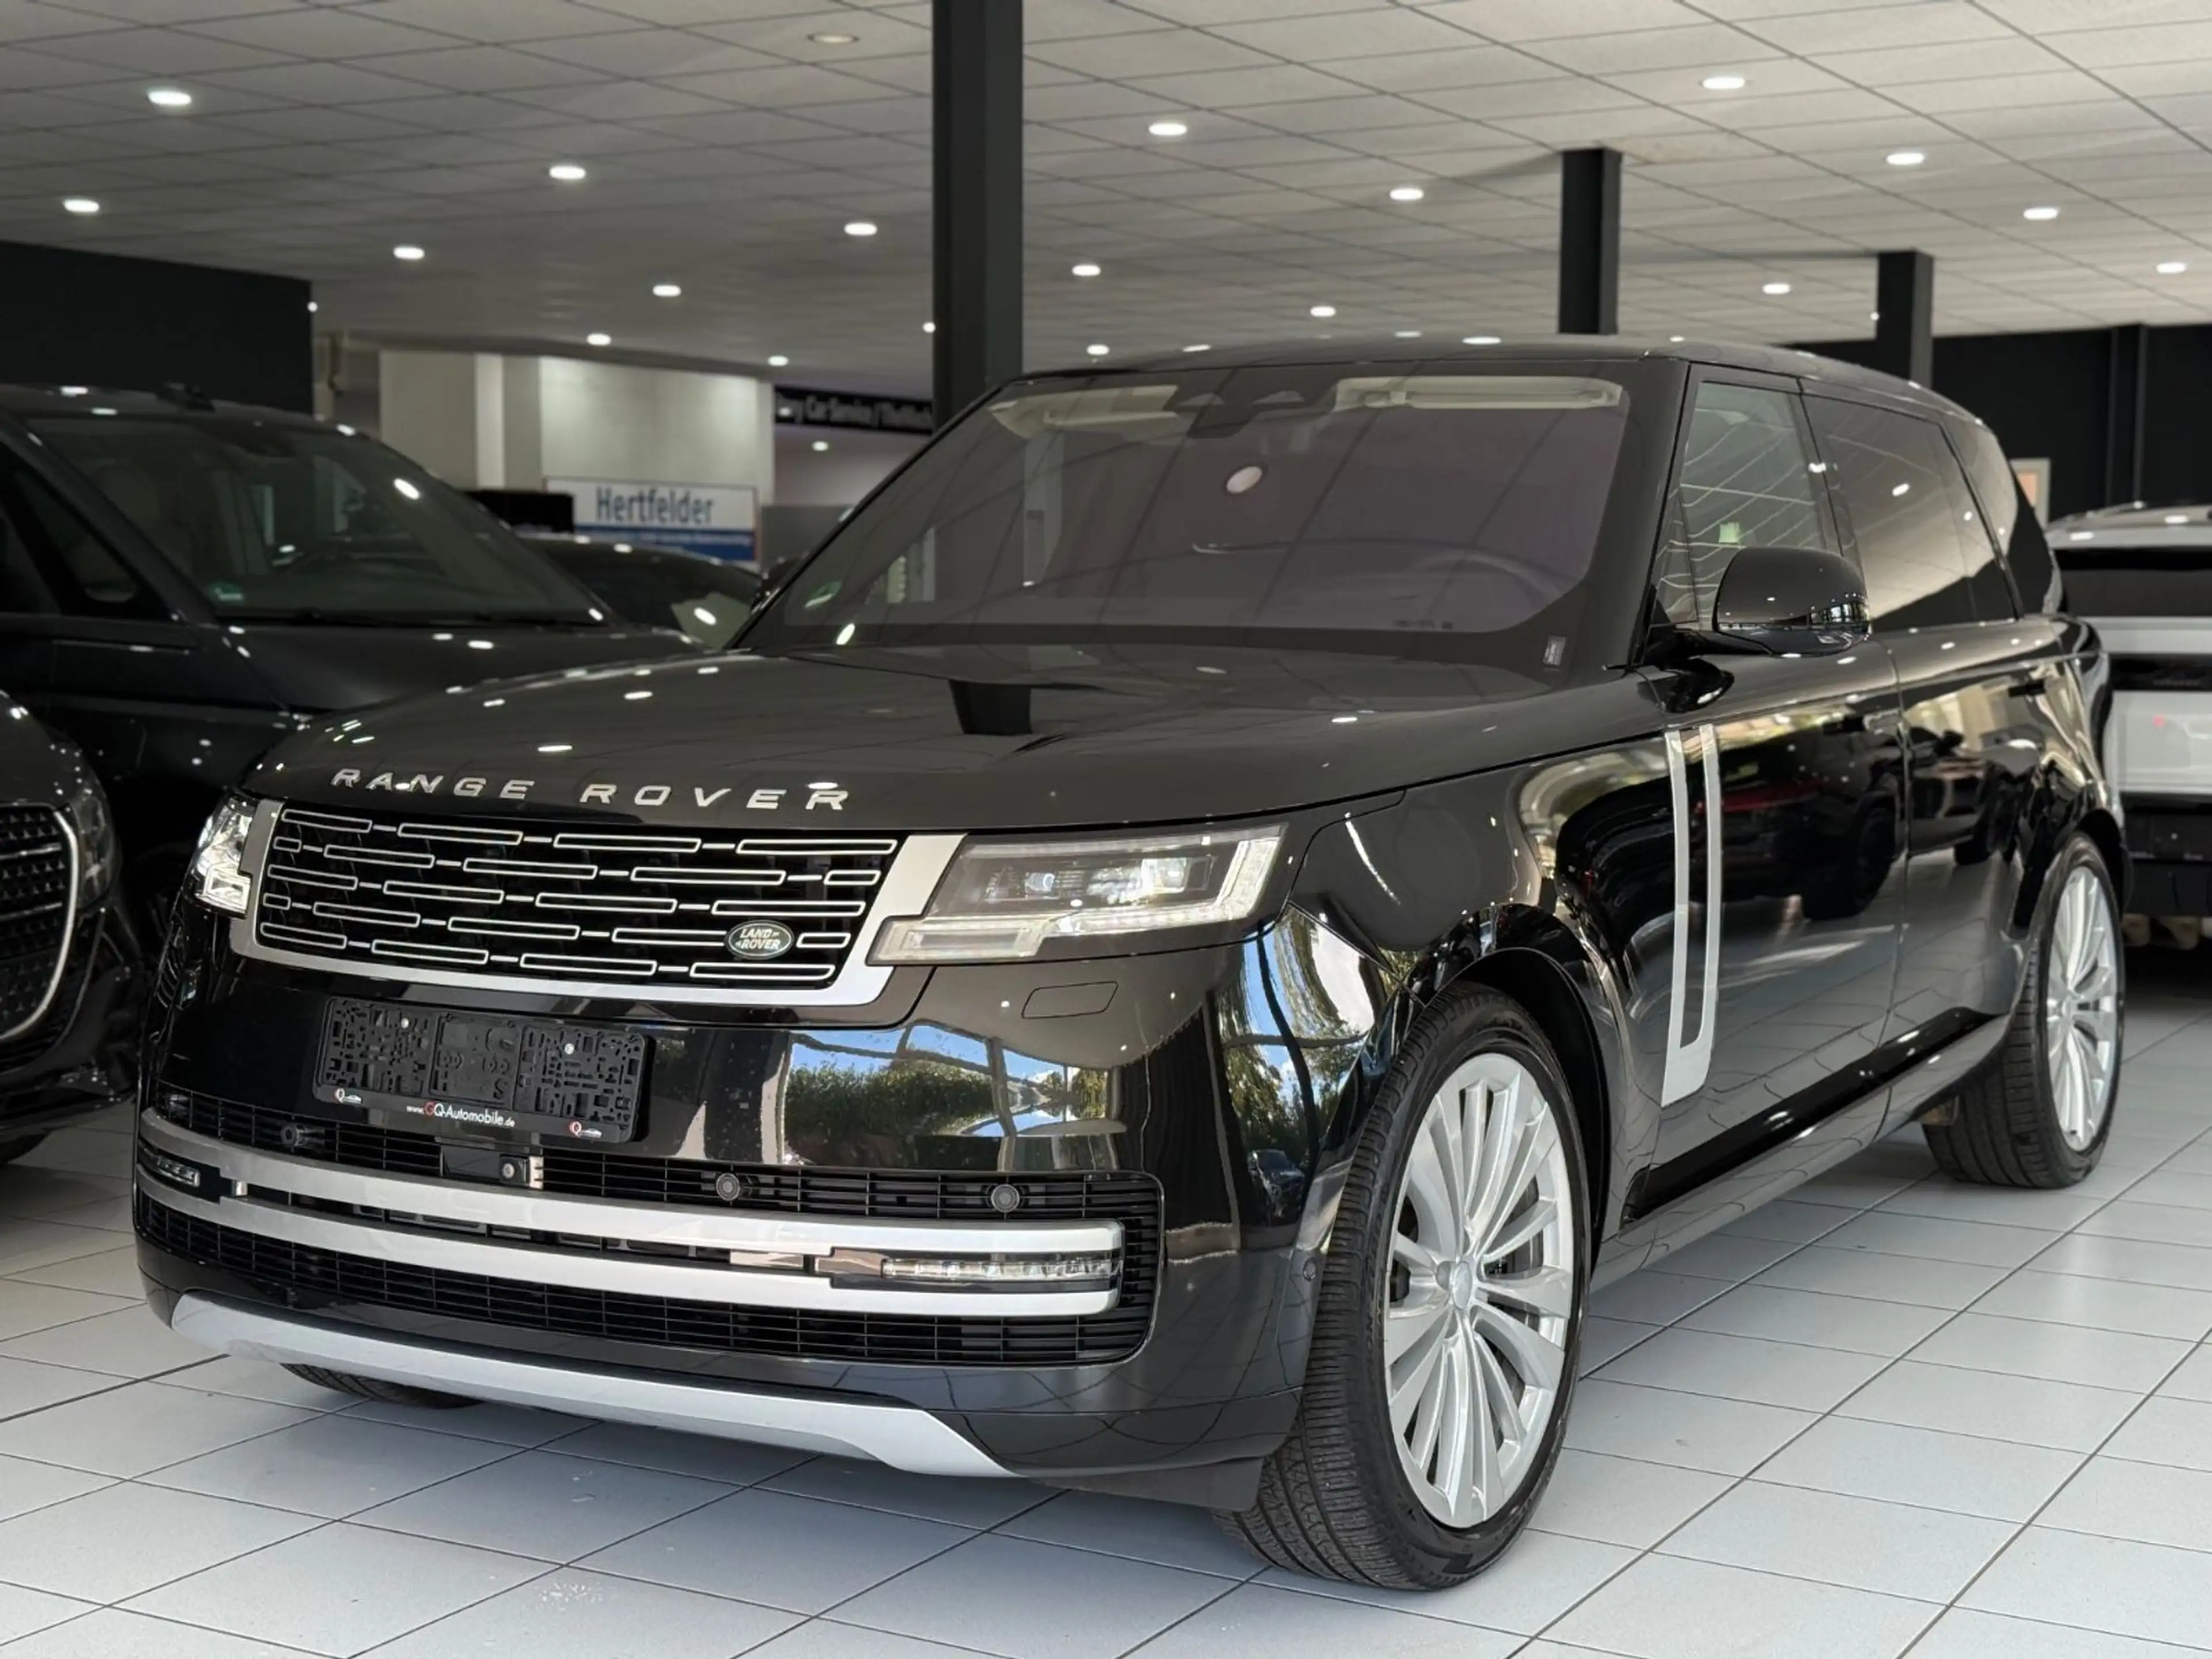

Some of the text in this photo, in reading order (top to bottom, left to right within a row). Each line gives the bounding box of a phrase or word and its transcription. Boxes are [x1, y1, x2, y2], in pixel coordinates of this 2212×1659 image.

[596, 487, 714, 524] Hertfelder
[330, 768, 849, 810] RANGE ROVER
[740, 928, 772, 938] LAND
[740, 938, 781, 949] ROVER
